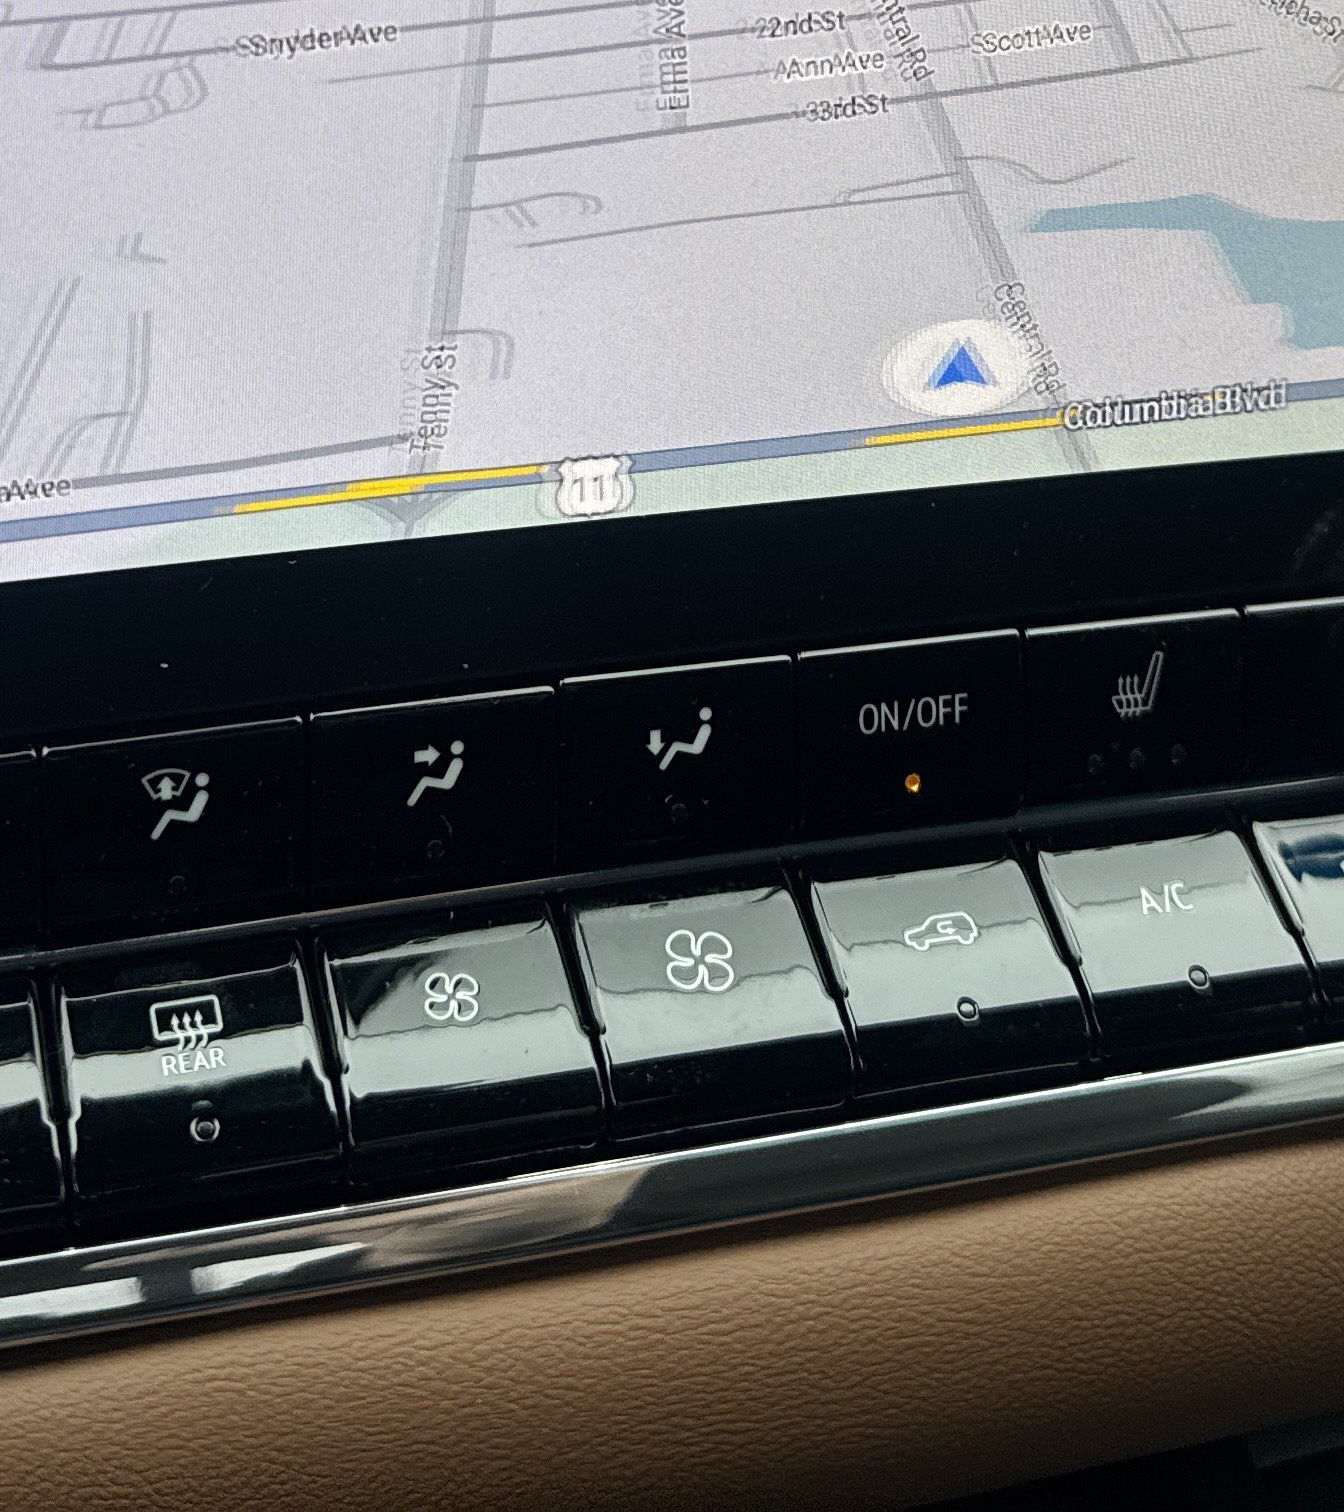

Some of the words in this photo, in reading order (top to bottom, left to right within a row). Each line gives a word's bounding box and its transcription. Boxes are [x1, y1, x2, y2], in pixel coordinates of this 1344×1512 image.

[244, 26, 340, 60] Snyder
[347, 23, 398, 46] Ave
[980, 25, 1043, 54] Scott
[1048, 20, 1092, 45] Ave
[664, 44, 690, 110] Erma
[908, 45, 935, 82] Rd
[573, 474, 606, 504] 11
[858, 692, 969, 735] ON/OFF
[1141, 880, 1194, 916] A/C
[160, 1047, 228, 1076] REAR
